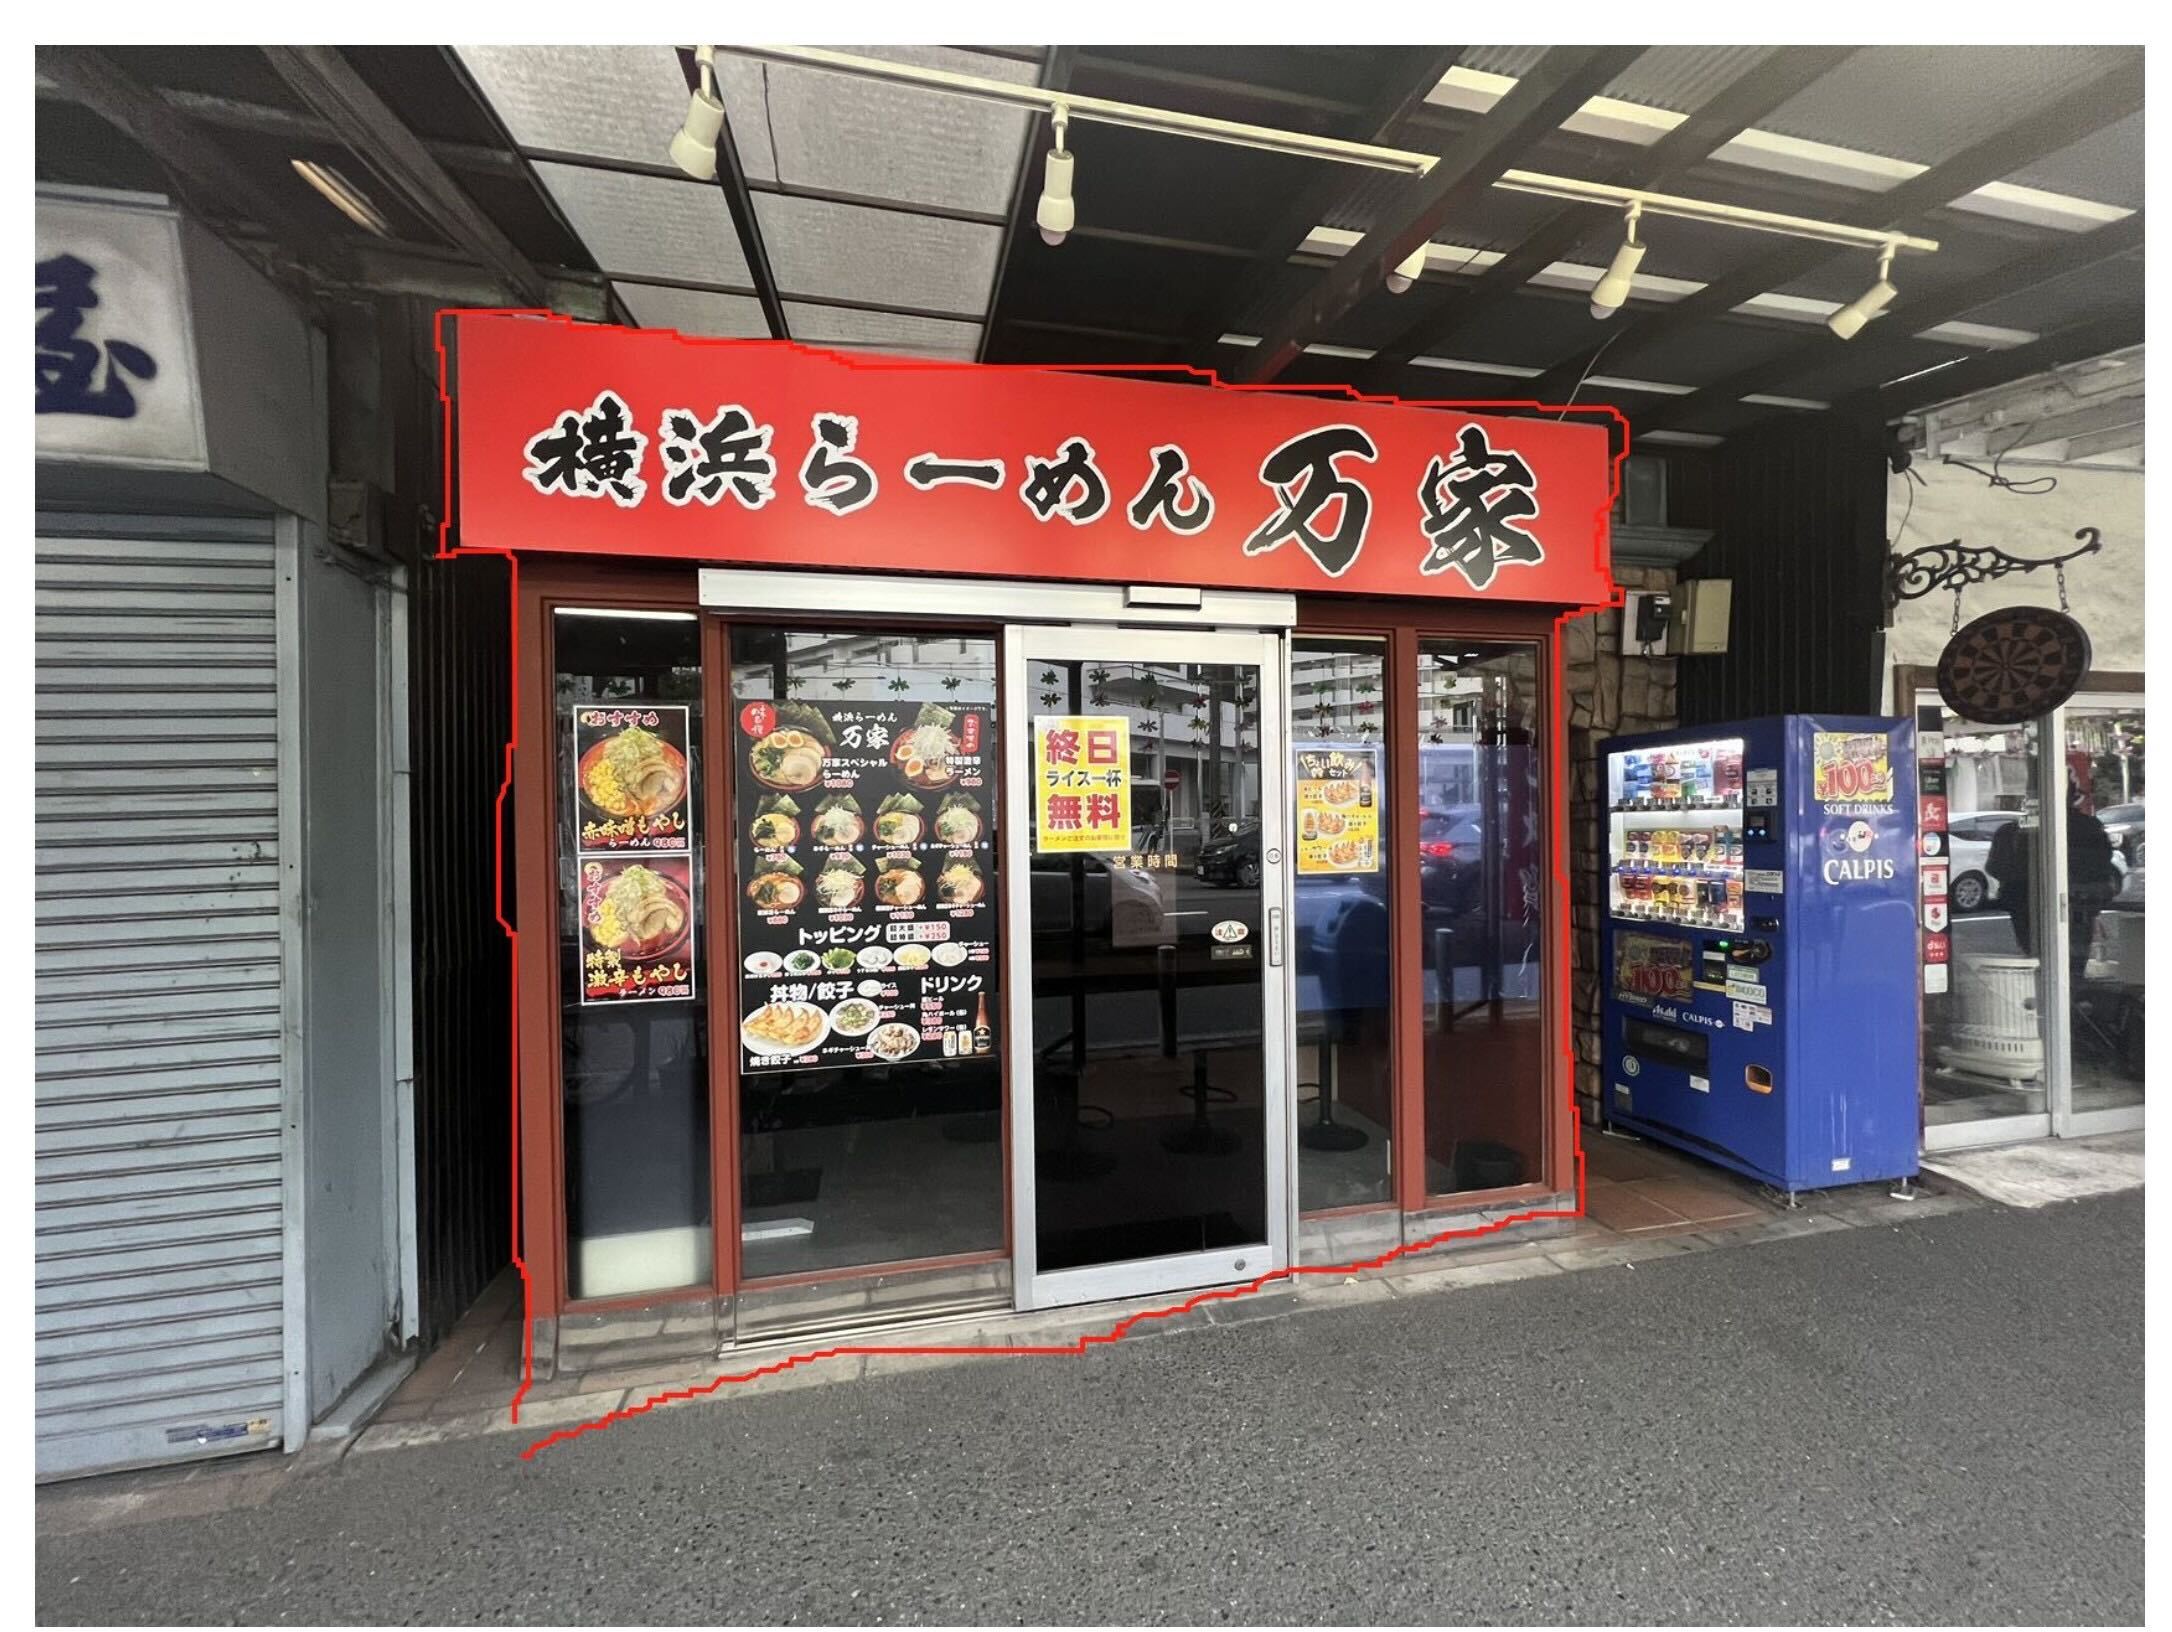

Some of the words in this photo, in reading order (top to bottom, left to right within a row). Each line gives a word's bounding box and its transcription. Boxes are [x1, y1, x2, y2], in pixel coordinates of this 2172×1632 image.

[524, 390, 1215, 537] 横浜らーめん
[1242, 422, 1547, 591] 万家
[588, 710, 660, 727] おすすめ
[832, 711, 898, 722] 横浜らーめん
[840, 723, 889, 750] 万家
[1046, 729, 1118, 765] 終日
[822, 769, 860, 779] らーめん
[945, 766, 981, 776] ラーメン
[1046, 769, 1122, 787] ライス一杯
[1047, 793, 1121, 830] 無料
[1823, 803, 1851, 815] SOFT
[1854, 804, 1895, 816] DRINKS
[582, 812, 686, 840] 赤味噌もやし
[609, 838, 651, 848] らーめん
[1113, 854, 1179, 870] 営業時間
[1824, 859, 1894, 885] CALPIS
[799, 924, 882, 945] トッピング
[586, 949, 622, 970] 特製
[587, 963, 688, 988] 激辛もやし
[921, 975, 983, 995] ドリンク
[619, 986, 656, 997] ラーメン
[770, 981, 854, 1003] 丼物/餃子
[1652, 1004, 1677, 1018] Asahi
[1682, 1012, 1713, 1025] CALPIS
